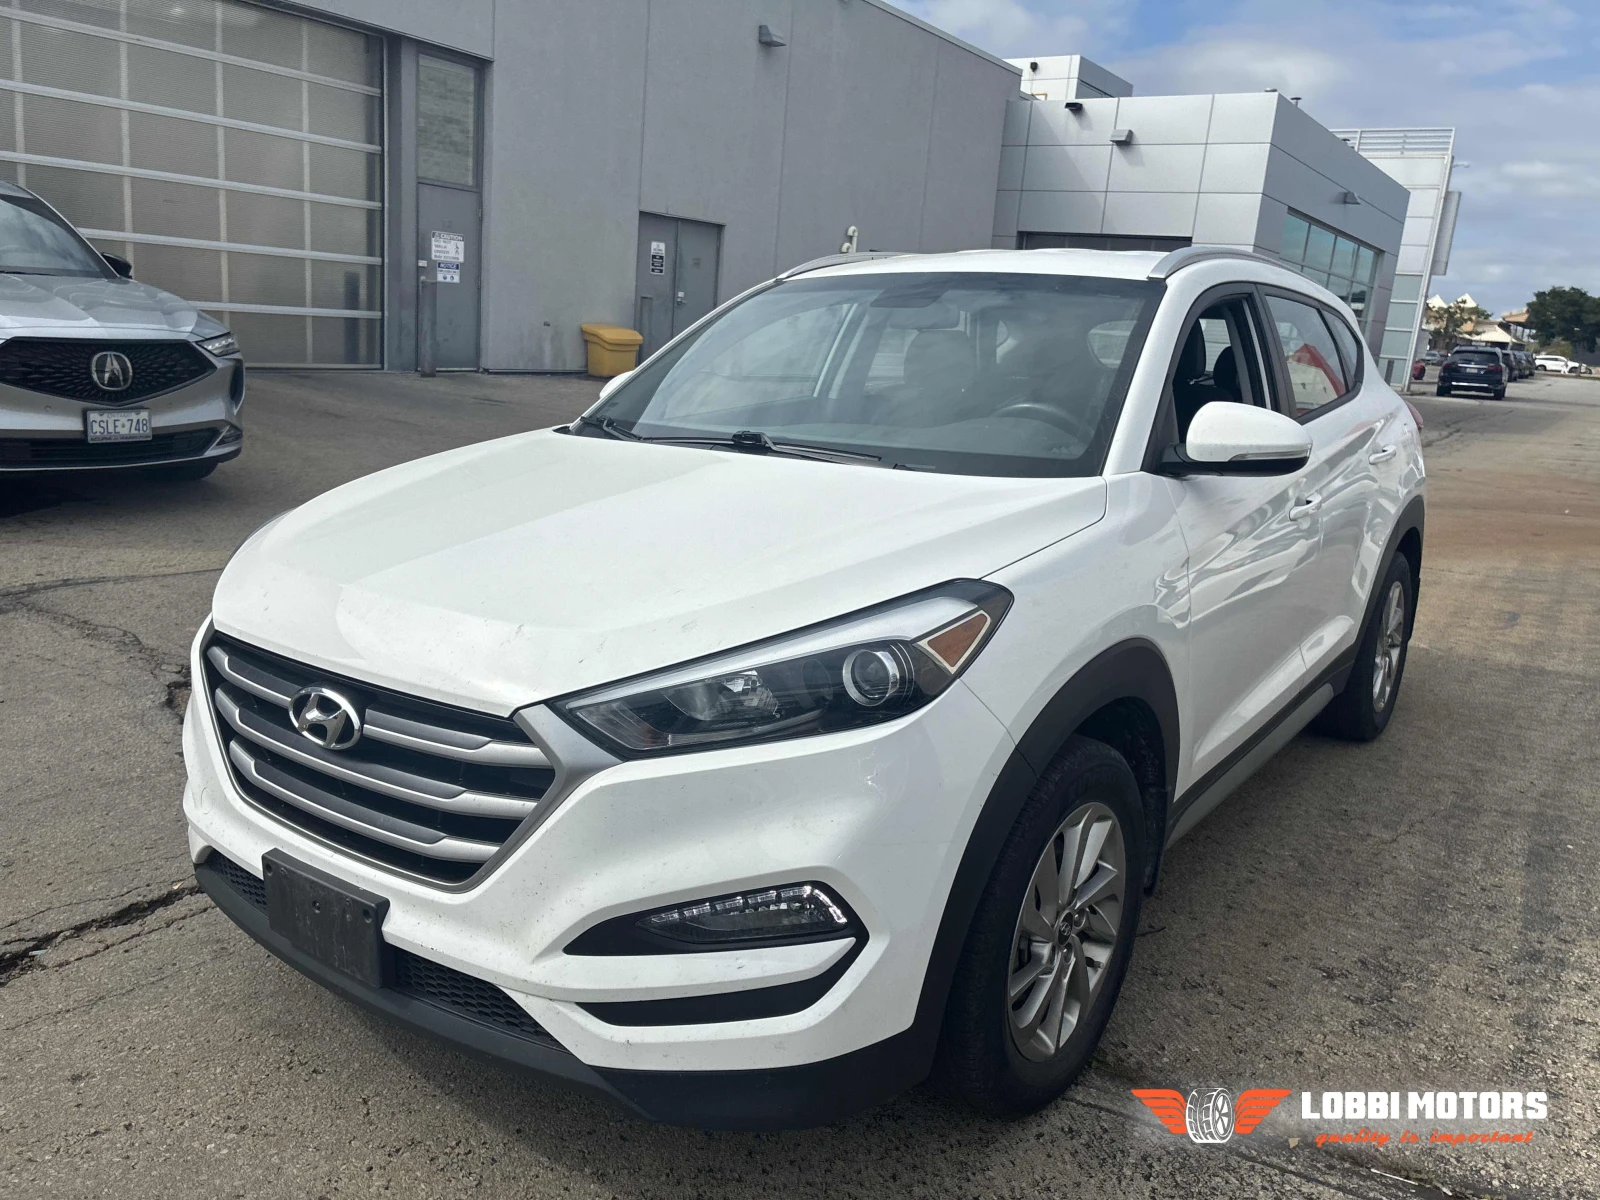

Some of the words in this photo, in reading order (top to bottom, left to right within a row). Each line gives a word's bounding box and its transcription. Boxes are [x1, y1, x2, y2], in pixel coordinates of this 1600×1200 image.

[440, 233, 463, 241] CAUTION
[91, 419, 120, 434] CSLE
[127, 418, 148, 433] 748
